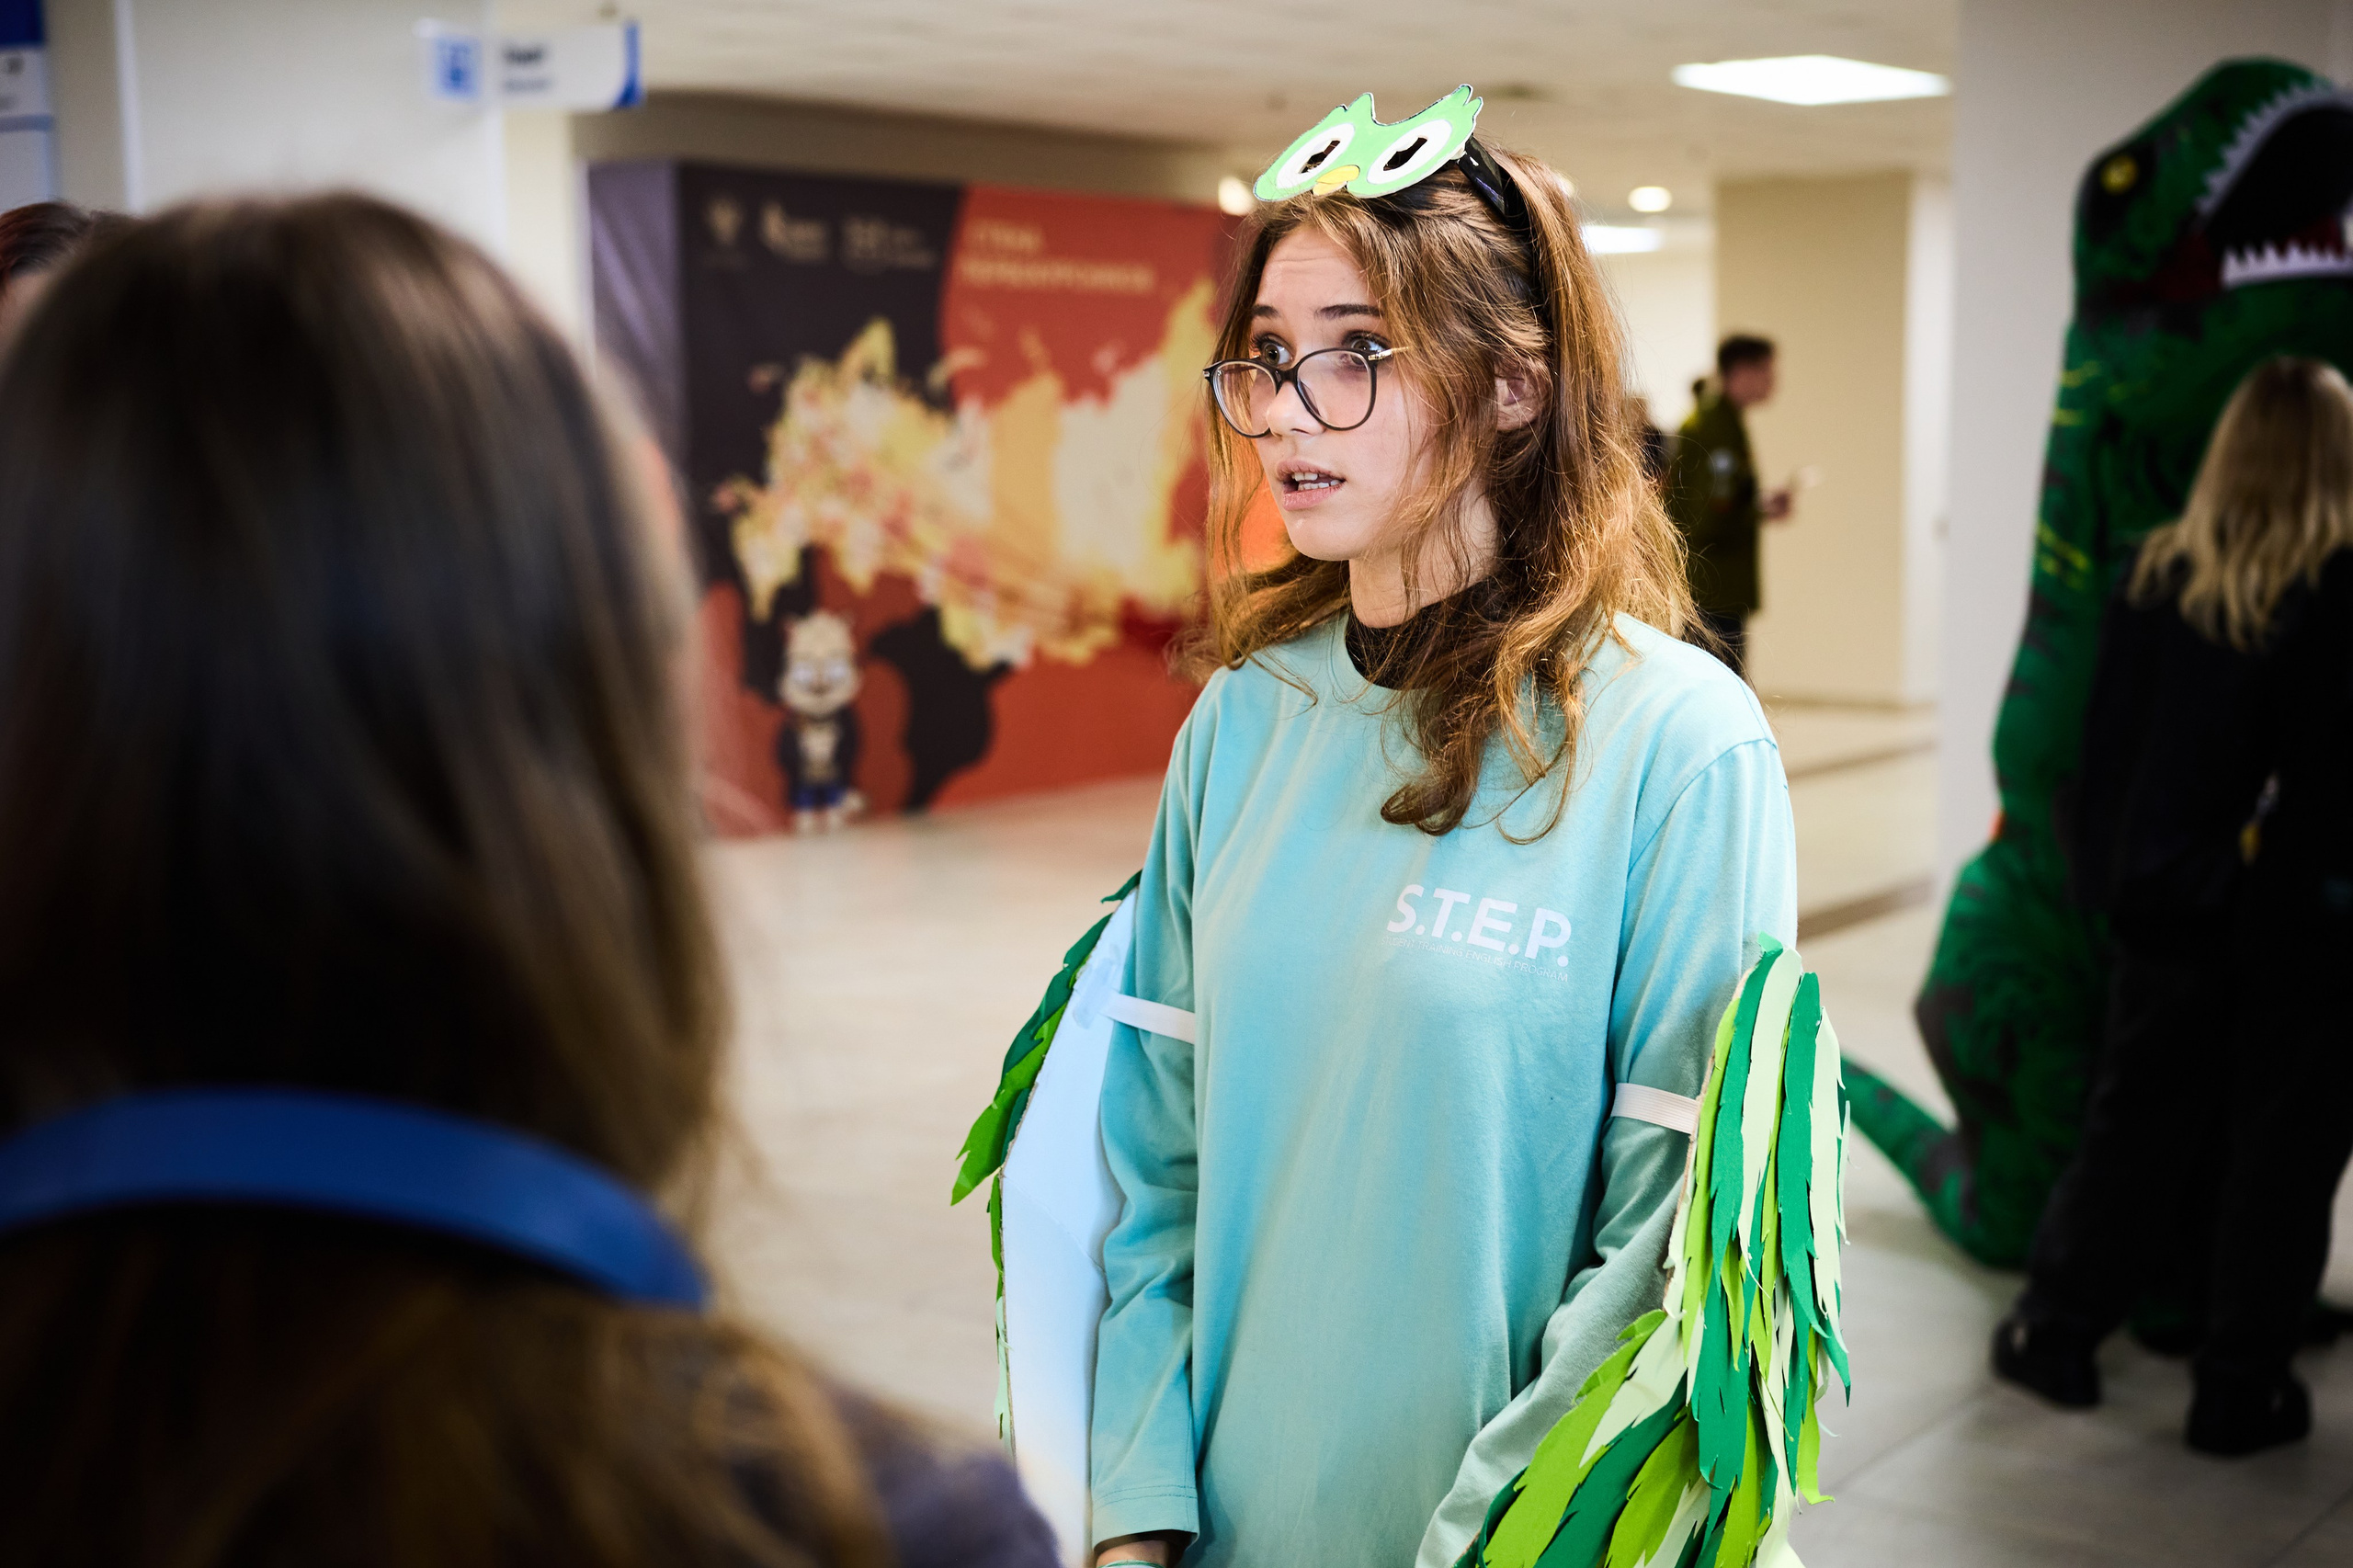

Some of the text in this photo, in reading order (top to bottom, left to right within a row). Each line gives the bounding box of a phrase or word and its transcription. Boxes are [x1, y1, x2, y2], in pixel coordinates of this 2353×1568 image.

[1386, 883, 1572, 968] S.T.E.P.
[1381, 936, 1568, 983] STUDENT TRAINING ENGLISH PROGRAM
